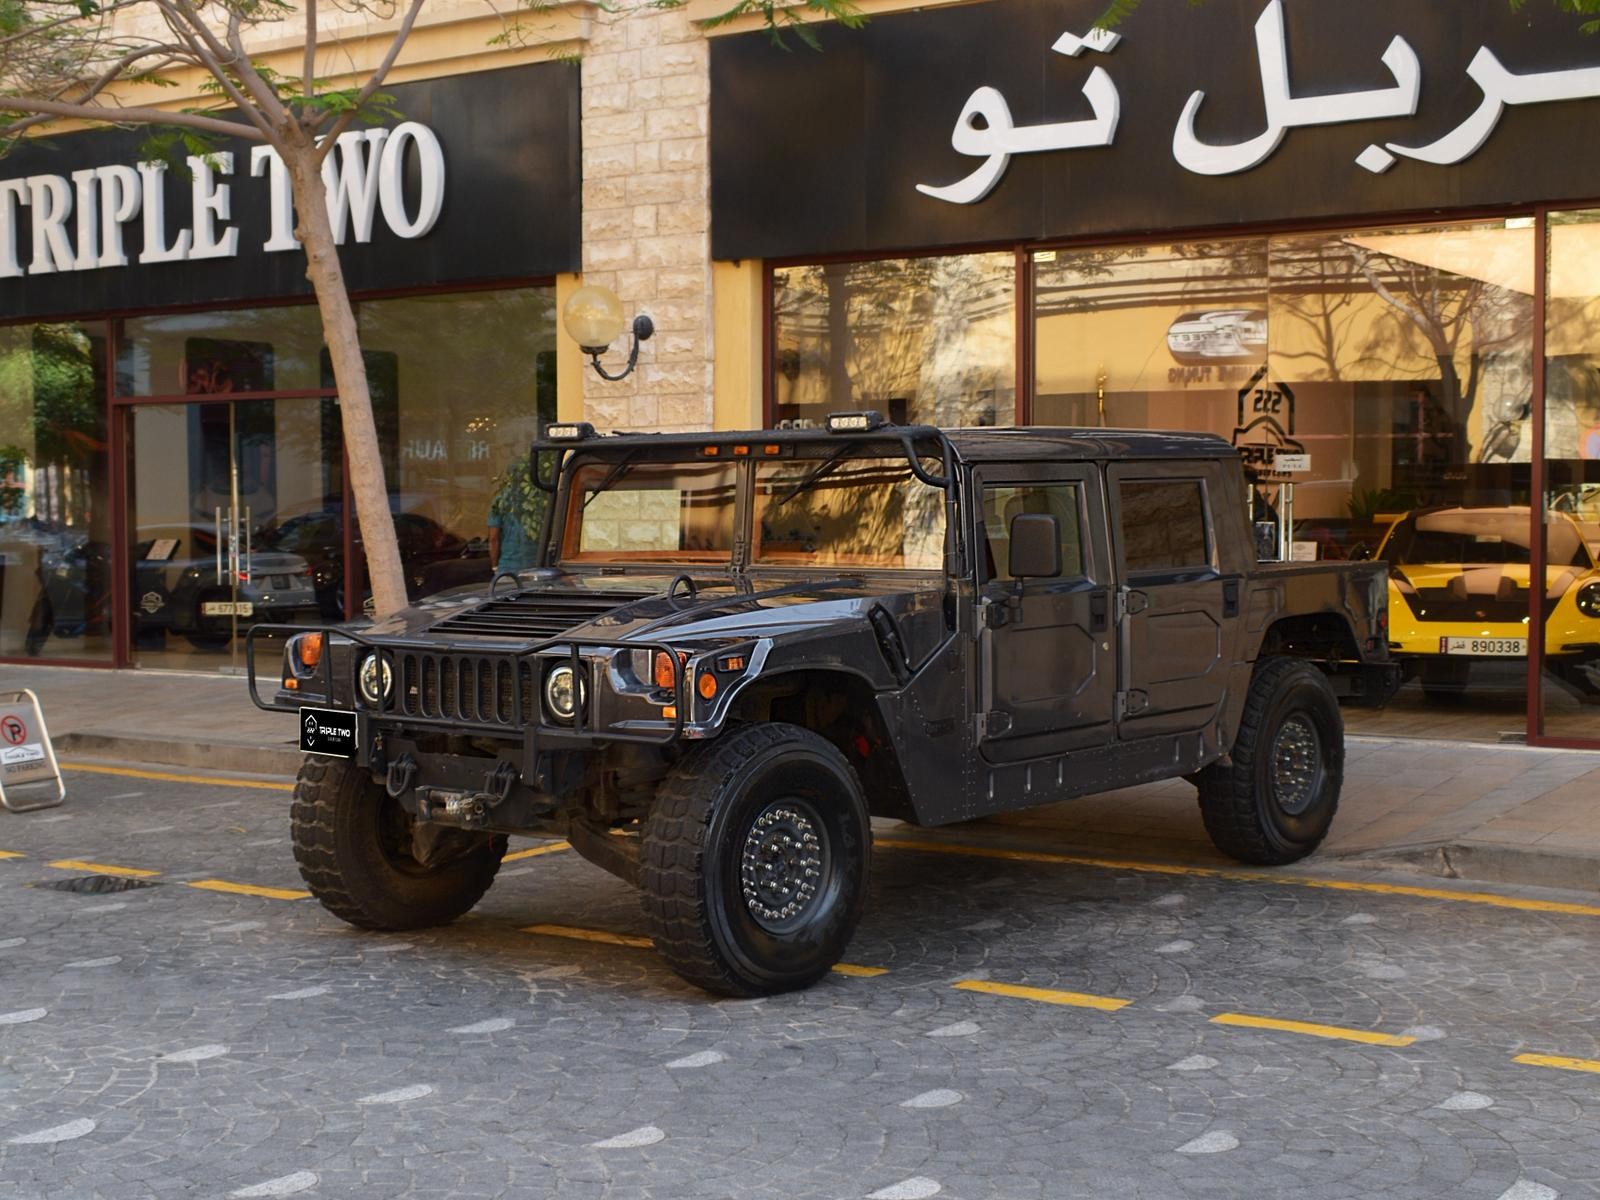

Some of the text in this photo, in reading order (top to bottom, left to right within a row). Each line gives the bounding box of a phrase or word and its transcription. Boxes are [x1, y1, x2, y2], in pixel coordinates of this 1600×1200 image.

[915, 28, 1121, 204] تو
[0, 121, 446, 278] TRIPLE TWO
[1471, 640, 1520, 653] 890338
[338, 728, 350, 737] TWO
